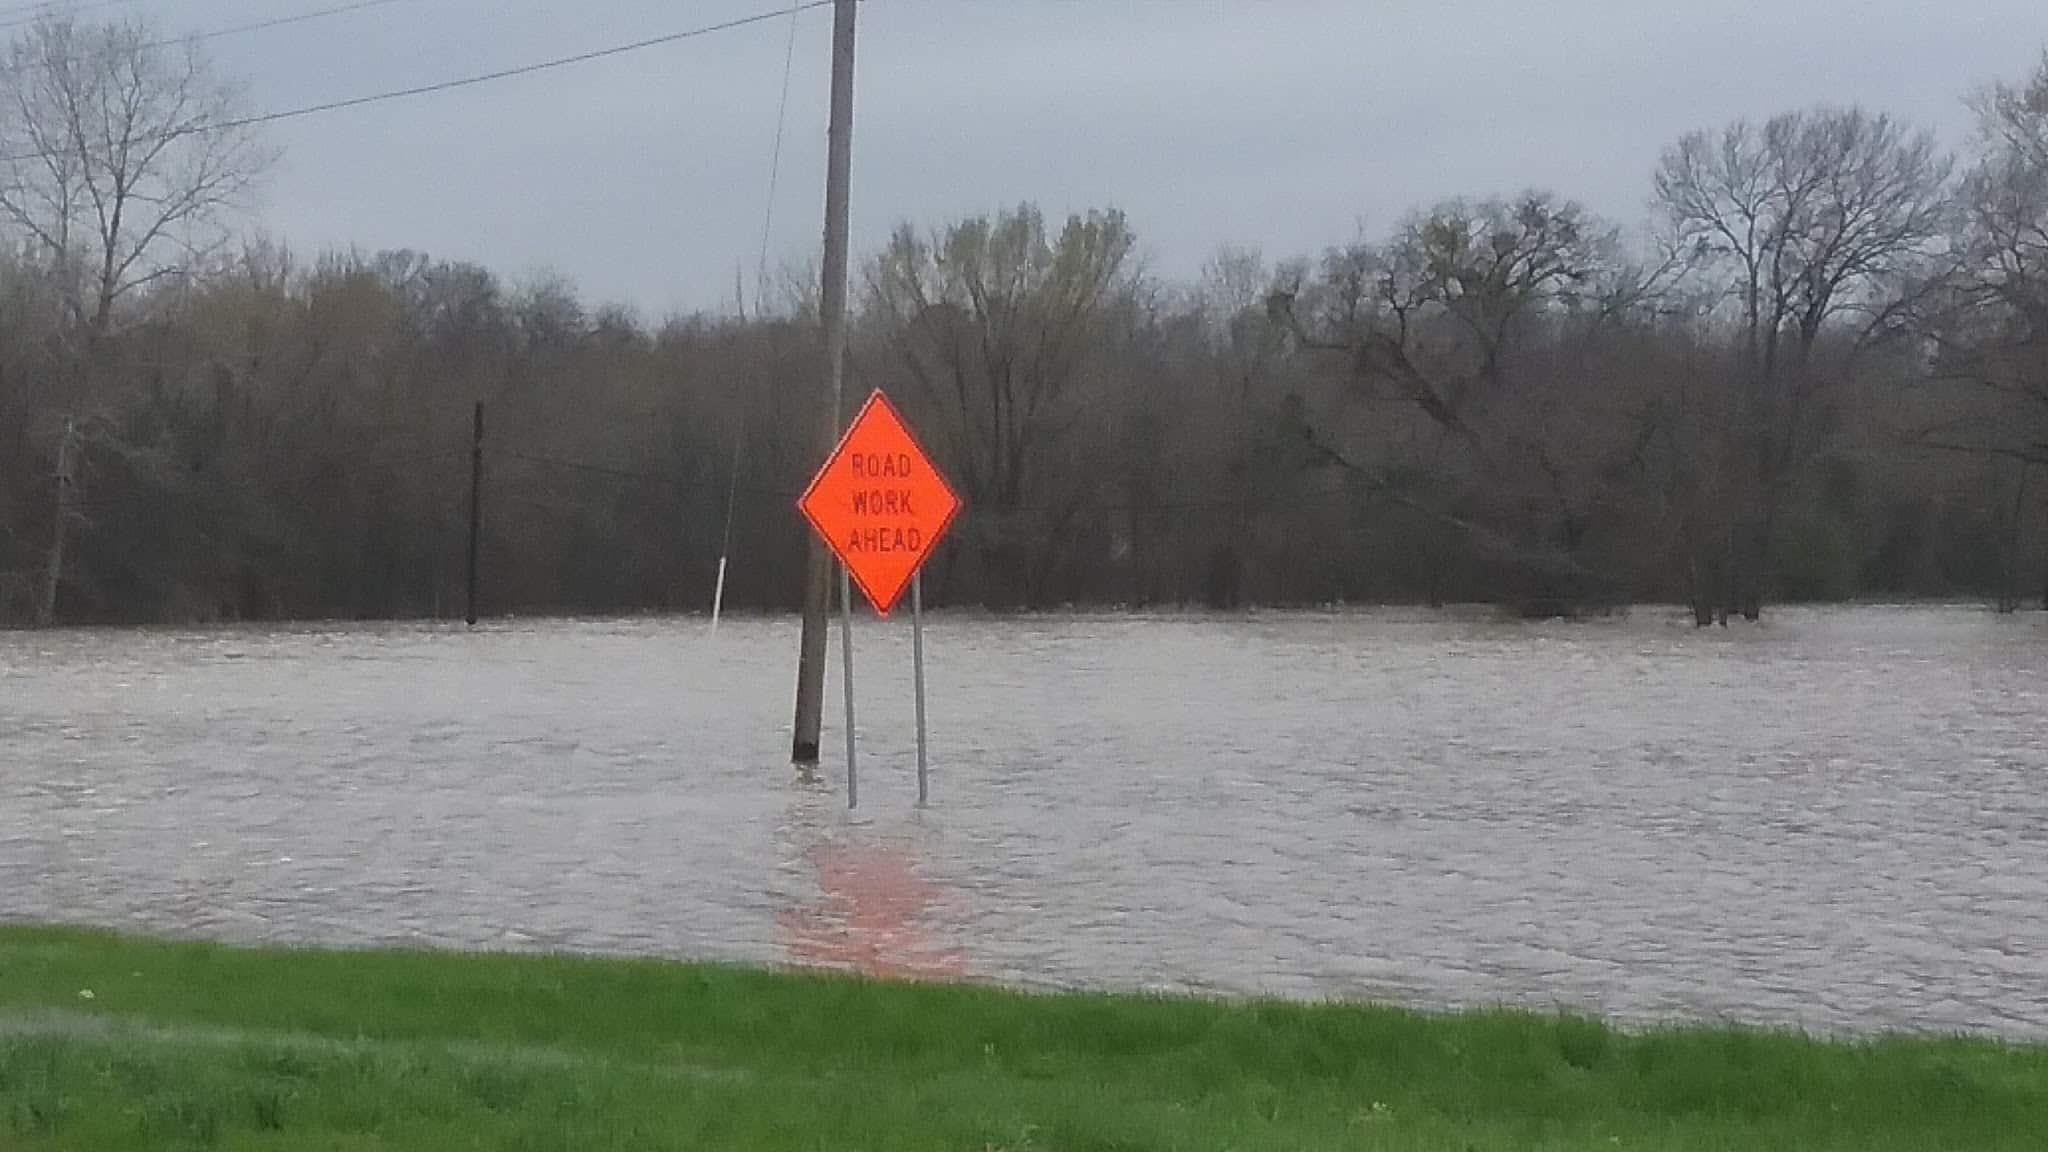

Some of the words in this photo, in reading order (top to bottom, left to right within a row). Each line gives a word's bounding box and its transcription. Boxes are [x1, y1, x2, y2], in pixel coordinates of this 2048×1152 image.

[851, 453, 911, 478] ROAD
[852, 490, 914, 516] WORK
[848, 527, 921, 552] AHEAD
